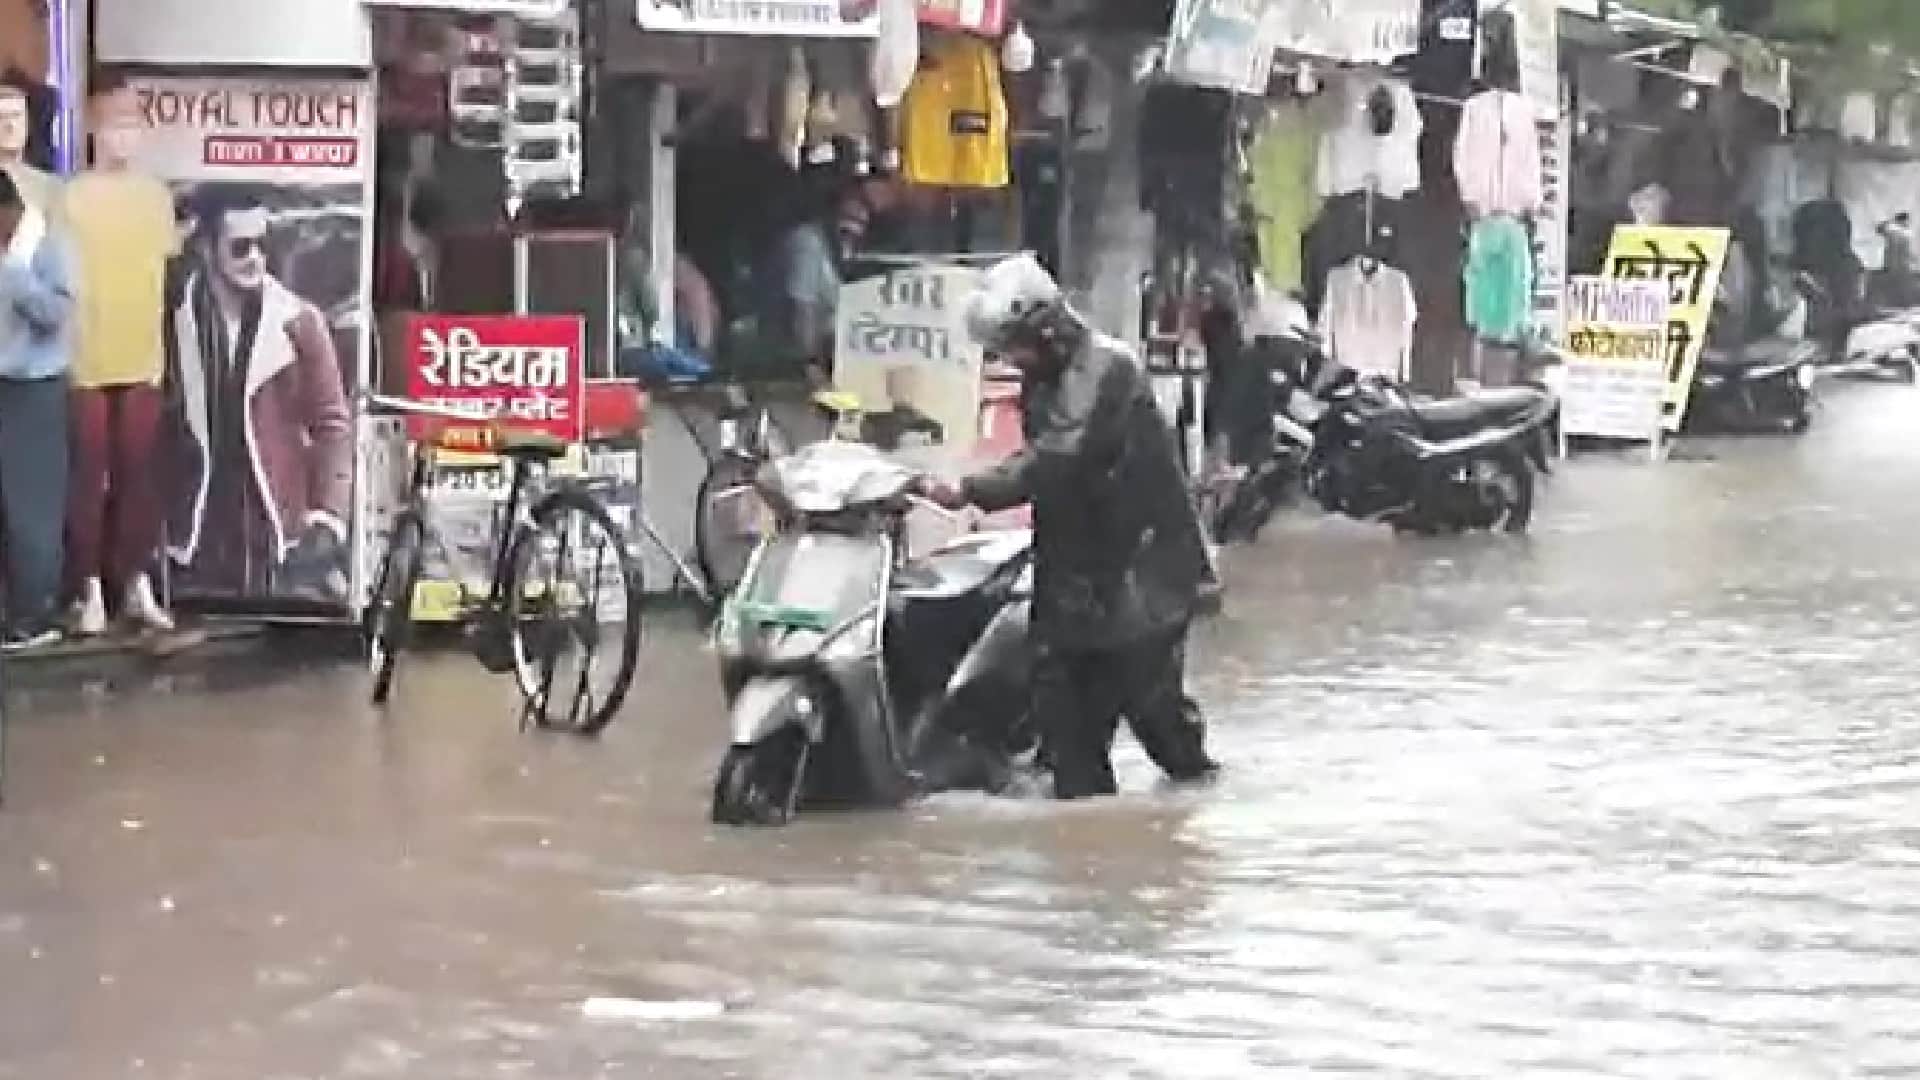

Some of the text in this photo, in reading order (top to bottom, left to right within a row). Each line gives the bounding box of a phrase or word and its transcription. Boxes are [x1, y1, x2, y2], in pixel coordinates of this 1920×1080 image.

[137, 89, 357, 128] ROYAL TOUCH
[418, 327, 569, 387] रेडियम
